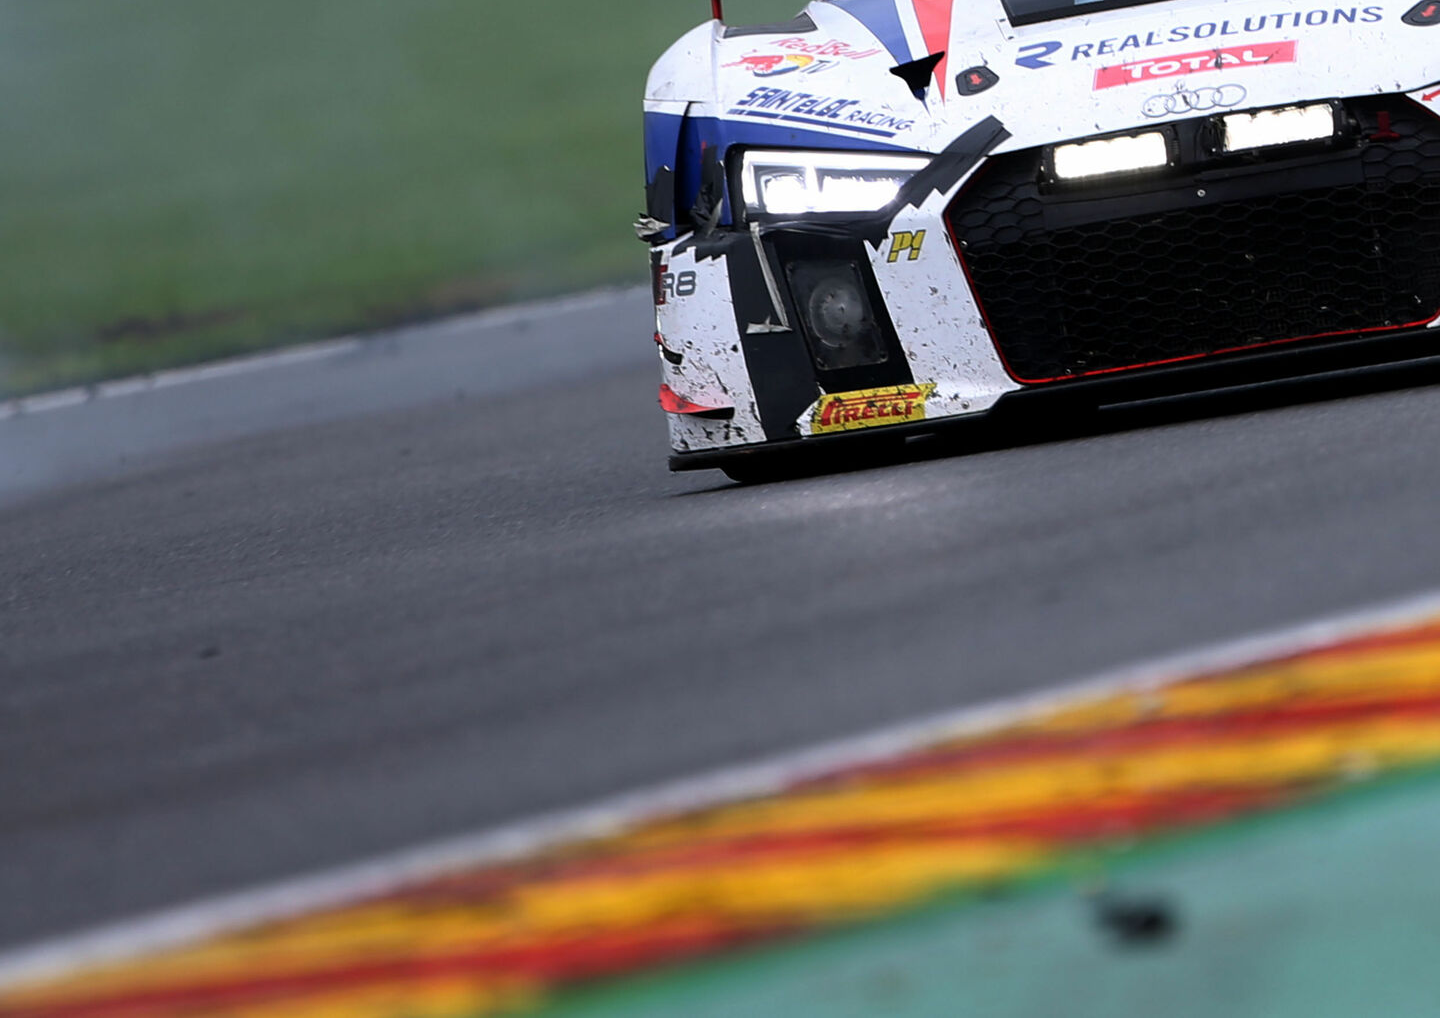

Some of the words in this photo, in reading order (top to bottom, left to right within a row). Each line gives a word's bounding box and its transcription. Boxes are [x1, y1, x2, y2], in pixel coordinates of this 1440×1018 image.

[1121, 50, 1268, 79] TOTAL
[845, 110, 915, 131] RACING
[661, 270, 697, 298] R8
[821, 392, 921, 427] PIRELLI
